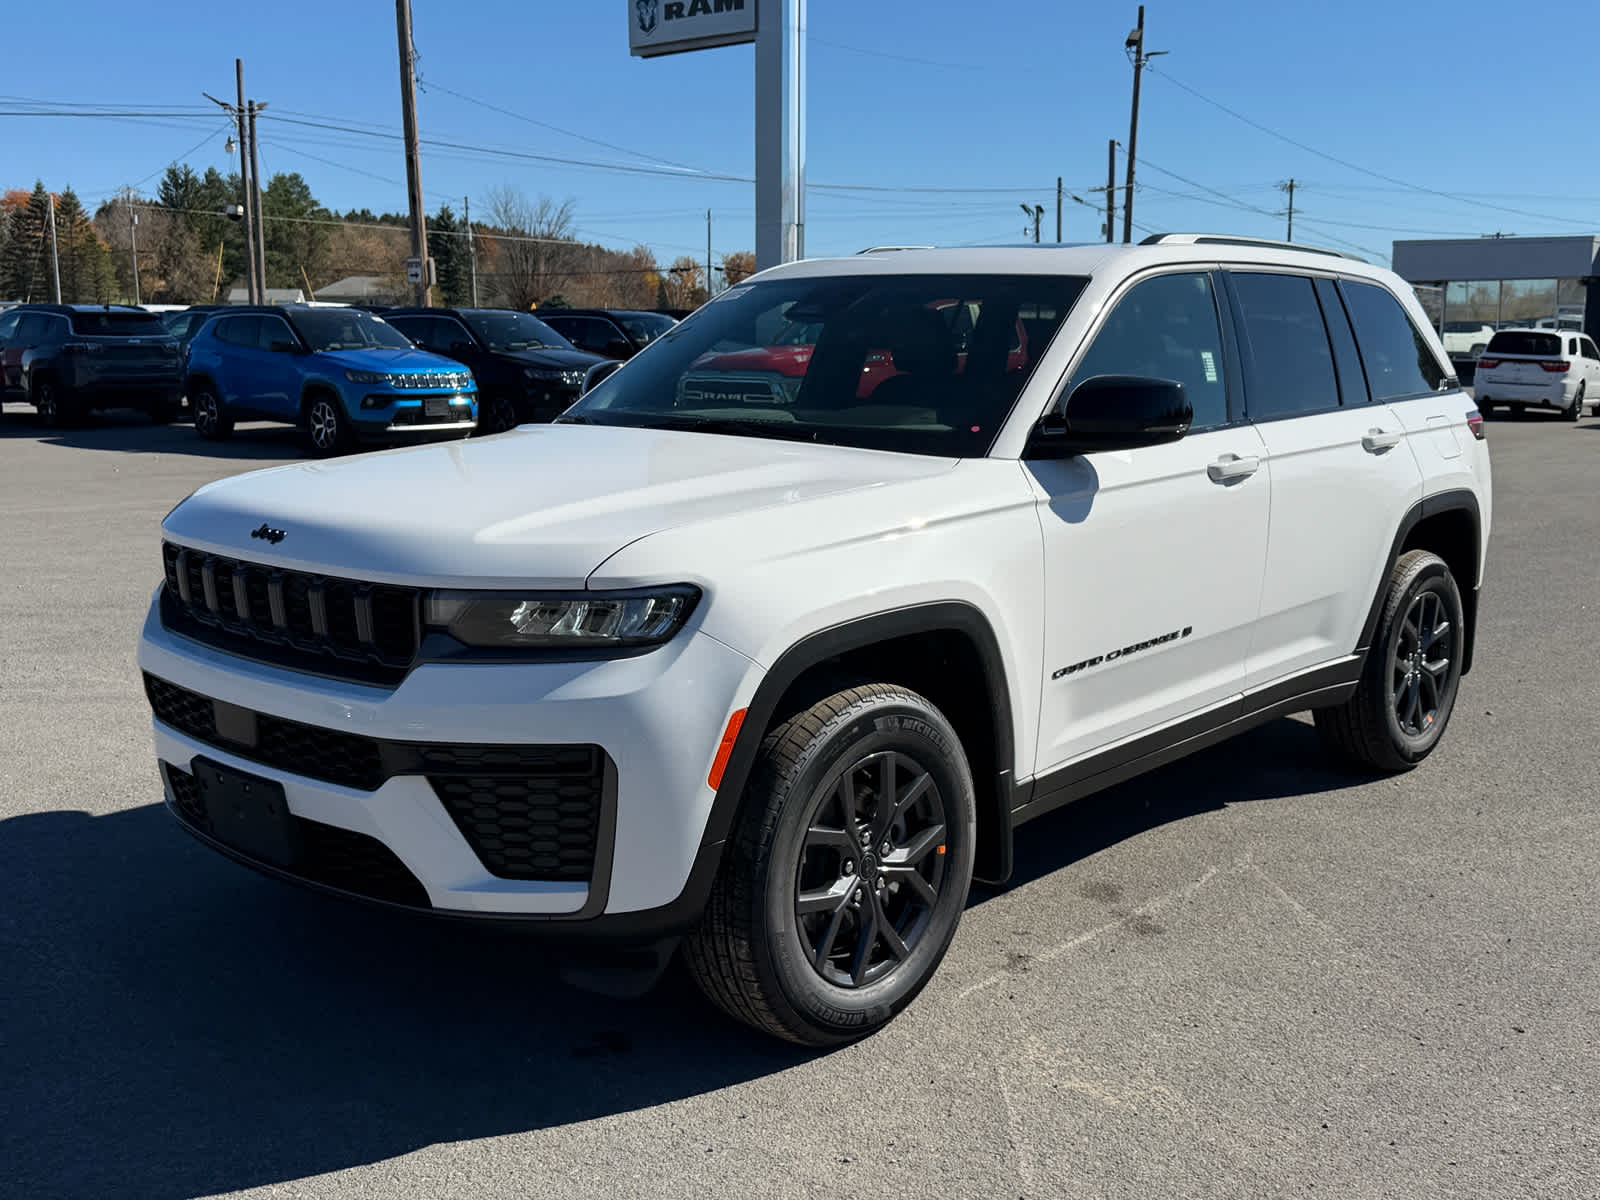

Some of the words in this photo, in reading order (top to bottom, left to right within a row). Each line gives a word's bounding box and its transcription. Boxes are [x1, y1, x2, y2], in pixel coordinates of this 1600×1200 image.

[664, 0, 744, 21] RAM
[251, 523, 288, 545] Jeep
[1051, 655, 1103, 681] GRAND
[1105, 630, 1180, 662] CHEROKEE
